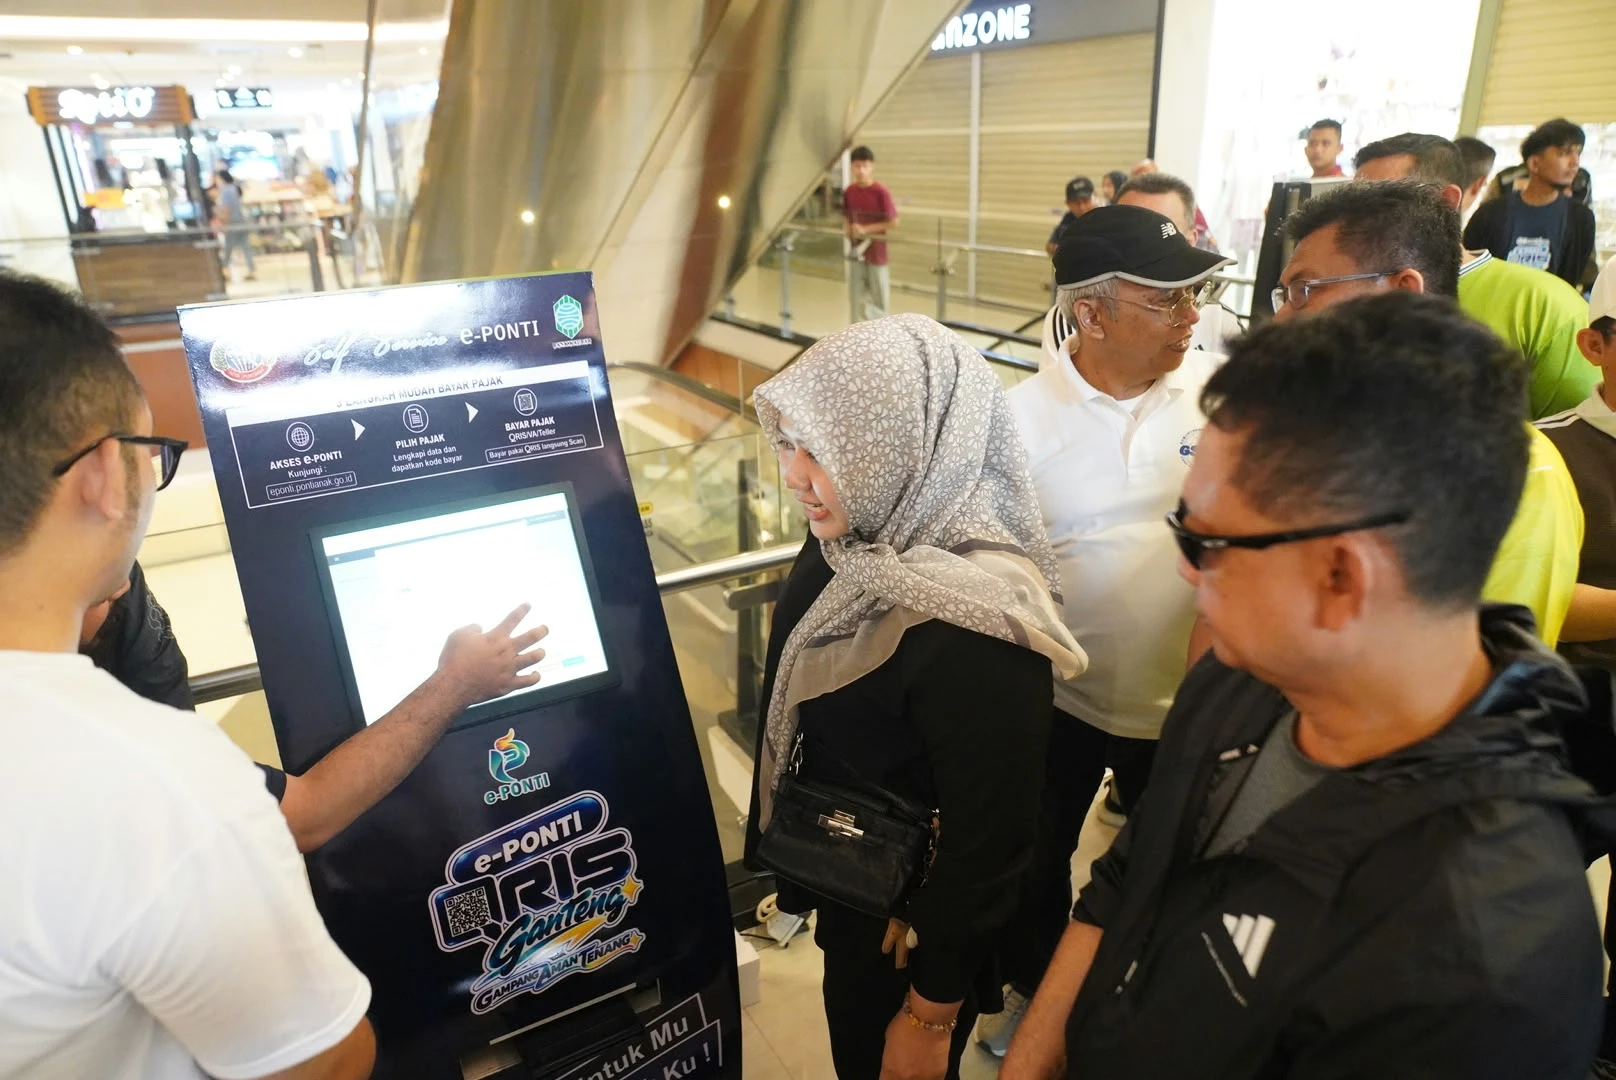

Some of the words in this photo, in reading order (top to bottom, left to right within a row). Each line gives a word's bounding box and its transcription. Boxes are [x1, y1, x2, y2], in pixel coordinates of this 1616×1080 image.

[931, 3, 1031, 50] nZONE
[460, 320, 540, 345] e-PONTI
[399, 385, 435, 399] MUDAH
[438, 380, 469, 393] BAYAR
[471, 376, 503, 389] PAJAK
[505, 420, 530, 432] BAYAR
[531, 416, 555, 428] PAJAK
[508, 428, 556, 443] QRIS/VA/Teller
[395, 437, 418, 449] PILIH
[419, 434, 446, 446] PAJAK
[489, 450, 507, 460] Bayar
[508, 447, 524, 457] pakai
[524, 443, 541, 454] QRIS
[541, 441, 568, 452] langsung
[568, 438, 583, 446] Scan
[270, 457, 302, 470] AKSES
[303, 450, 343, 465] e-PONTI
[391, 459, 424, 473] dapatkan
[425, 457, 442, 467] kode
[443, 454, 463, 465] bayar
[393, 449, 426, 463] Lengkapi
[427, 447, 443, 457] data
[443, 445, 457, 454] dan
[288, 466, 323, 479] Kunjungi
[270, 474, 353, 497] eponti.pontianak.go.id
[483, 772, 550, 805] e-PONTI
[474, 810, 583, 874] e-PONTI
[430, 829, 636, 951] QRIS
[475, 971, 539, 1010] GAMPANG
[533, 954, 578, 989] AMAN
[578, 934, 631, 968] TENANG
[578, 1044, 645, 1080] ntuk
[650, 1016, 689, 1051] Mu
[663, 1055, 697, 1080] Ku
